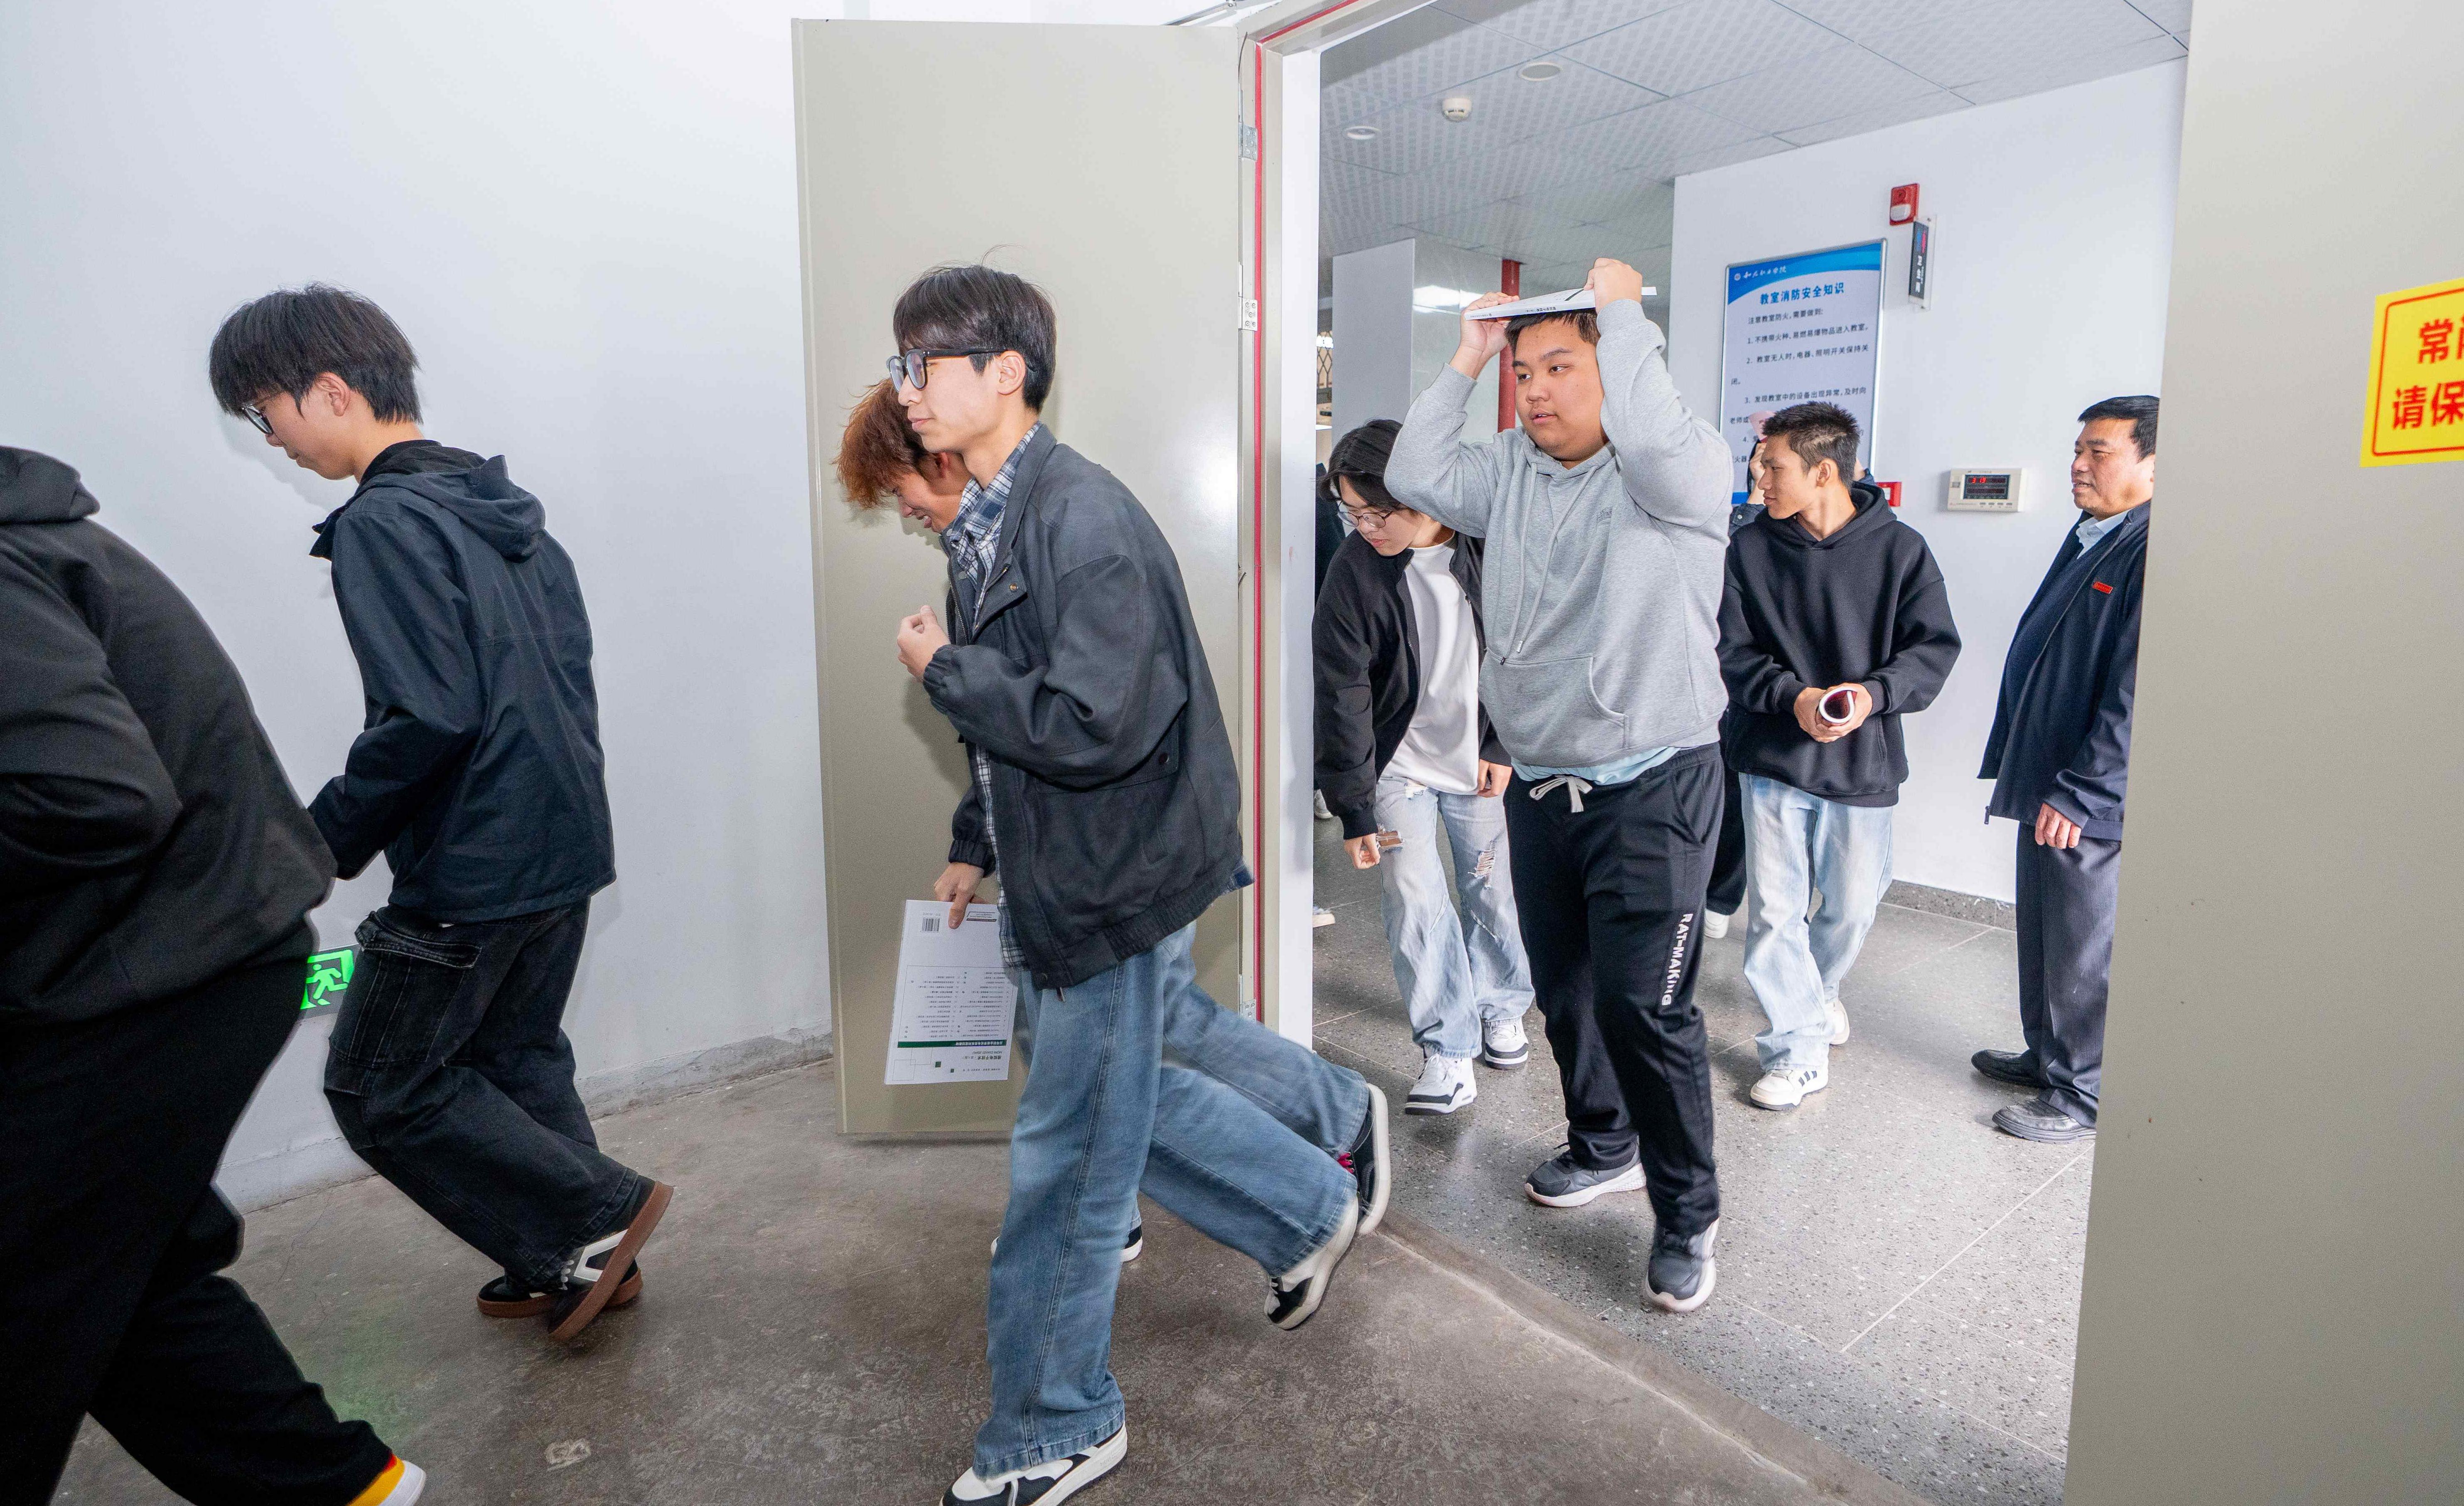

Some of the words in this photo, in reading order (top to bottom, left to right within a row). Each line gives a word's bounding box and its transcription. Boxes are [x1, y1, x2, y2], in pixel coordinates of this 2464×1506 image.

[1760, 283, 1845, 305] 教室消防安全知识
